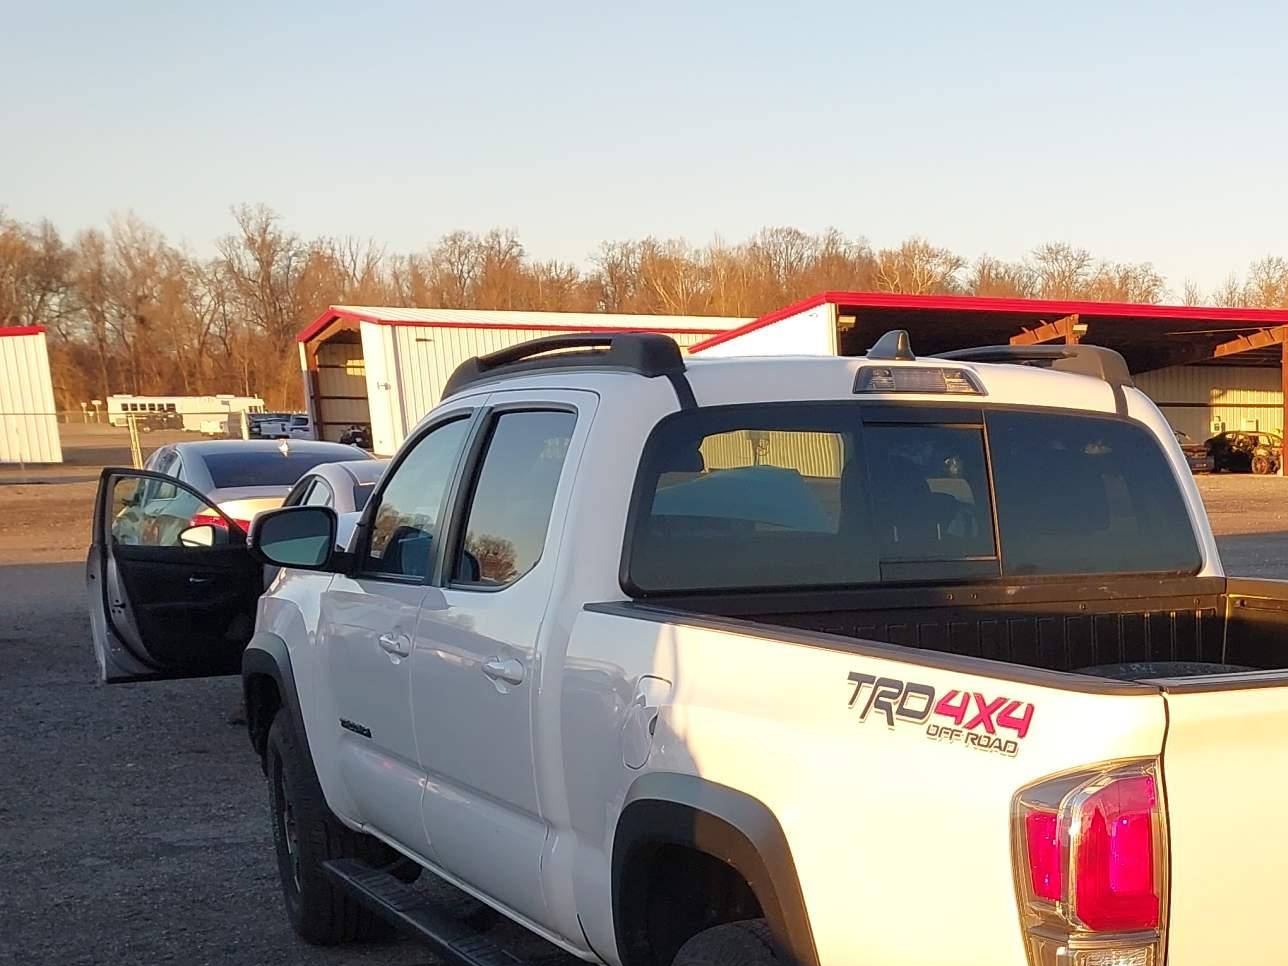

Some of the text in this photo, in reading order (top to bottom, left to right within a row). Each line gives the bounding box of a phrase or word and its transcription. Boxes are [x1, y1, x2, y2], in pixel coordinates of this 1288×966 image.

[848, 671, 1035, 739] TRD 4X4
[926, 724, 1018, 754] OFF ROAD
